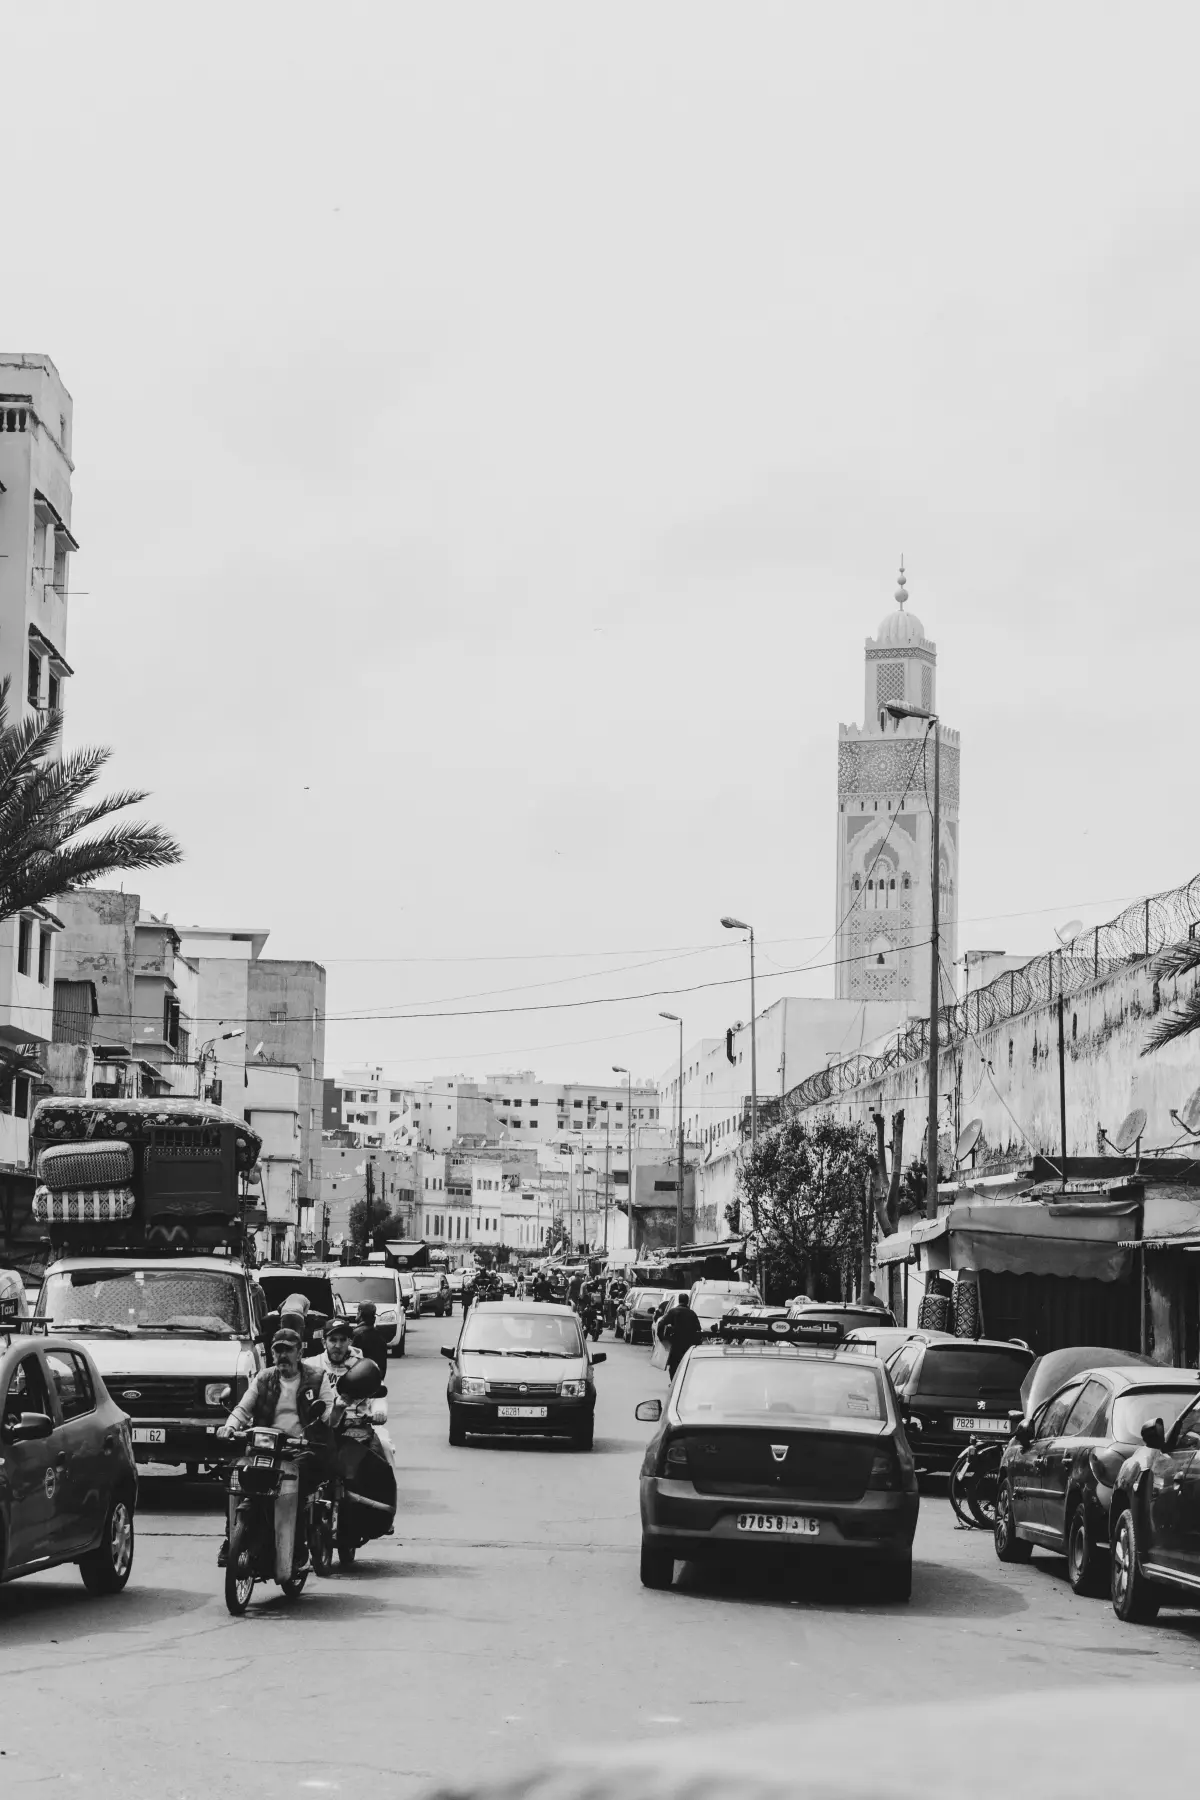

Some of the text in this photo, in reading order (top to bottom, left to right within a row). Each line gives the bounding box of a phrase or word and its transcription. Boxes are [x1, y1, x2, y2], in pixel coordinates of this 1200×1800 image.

[1, 1301, 15, 1315] Taxi
[793, 1323, 838, 1332] طاكسي
[956, 1418, 975, 1429] 7829
[149, 1430, 161, 1442] 62
[808, 1519, 816, 1532] 6
